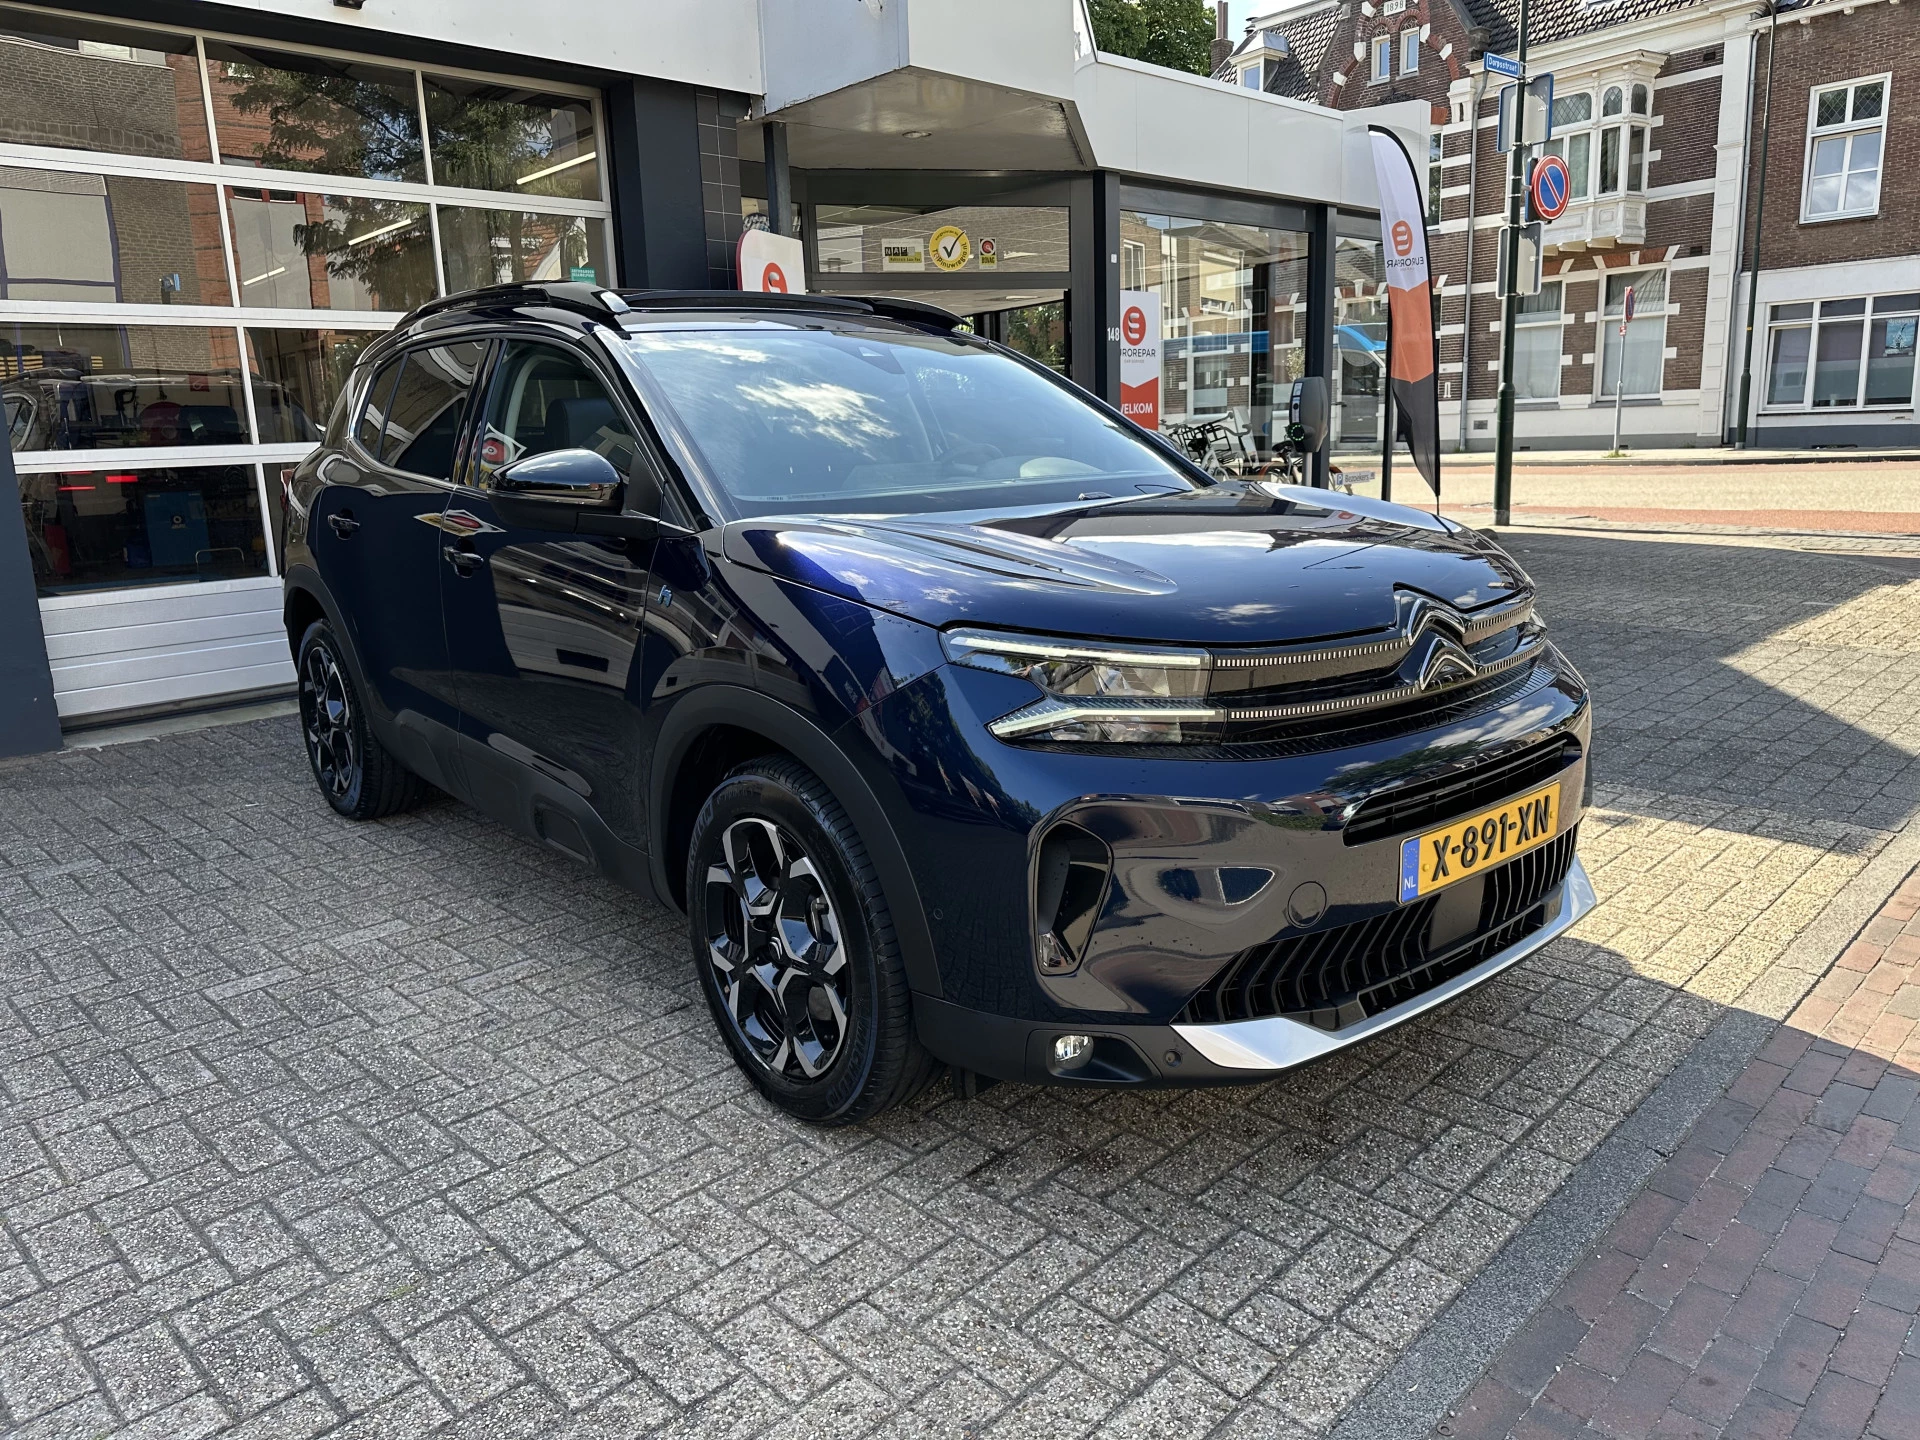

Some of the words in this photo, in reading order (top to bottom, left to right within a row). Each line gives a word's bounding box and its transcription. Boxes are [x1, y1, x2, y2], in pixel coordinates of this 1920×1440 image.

[1107, 327, 1120, 341] 148
[1120, 348, 1156, 358] ROREPAR
[1432, 795, 1550, 882] X-891-XN
[1404, 875, 1416, 891] NL
